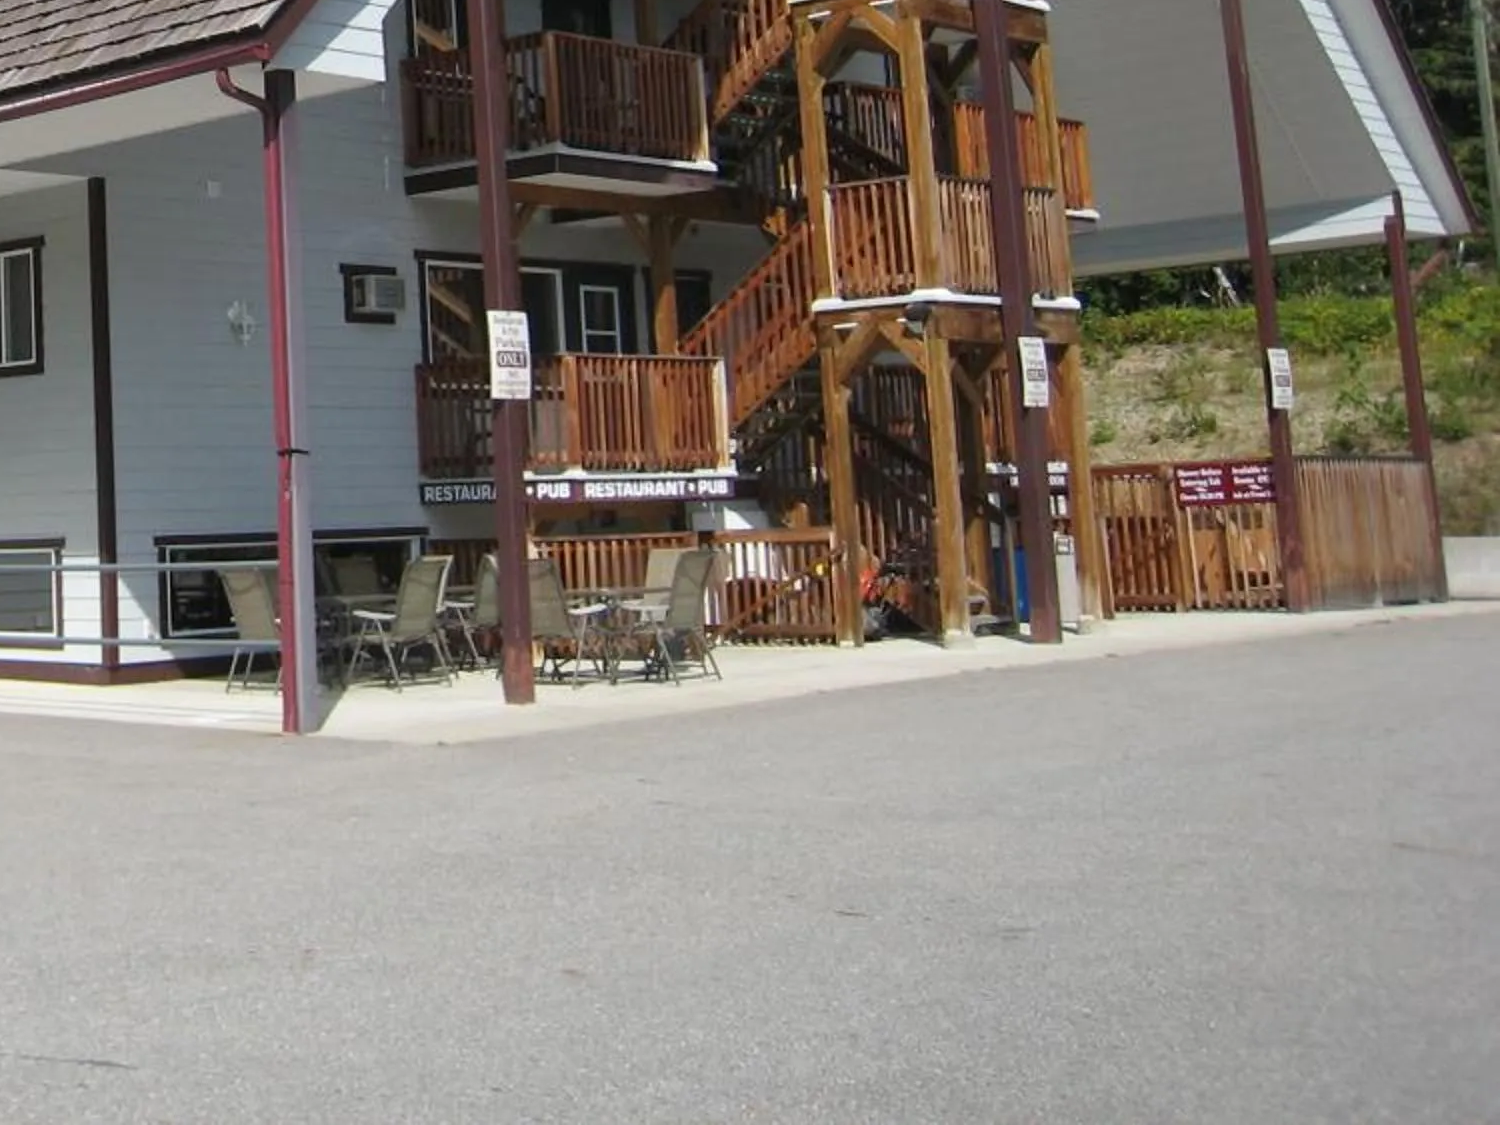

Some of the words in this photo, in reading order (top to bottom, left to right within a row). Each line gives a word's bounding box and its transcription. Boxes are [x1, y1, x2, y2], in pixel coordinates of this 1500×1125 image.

[424, 484, 497, 501] RESTAUR
[537, 482, 571, 499] PUB
[584, 480, 686, 498] RESTAURANT
[697, 478, 728, 494] PUB
